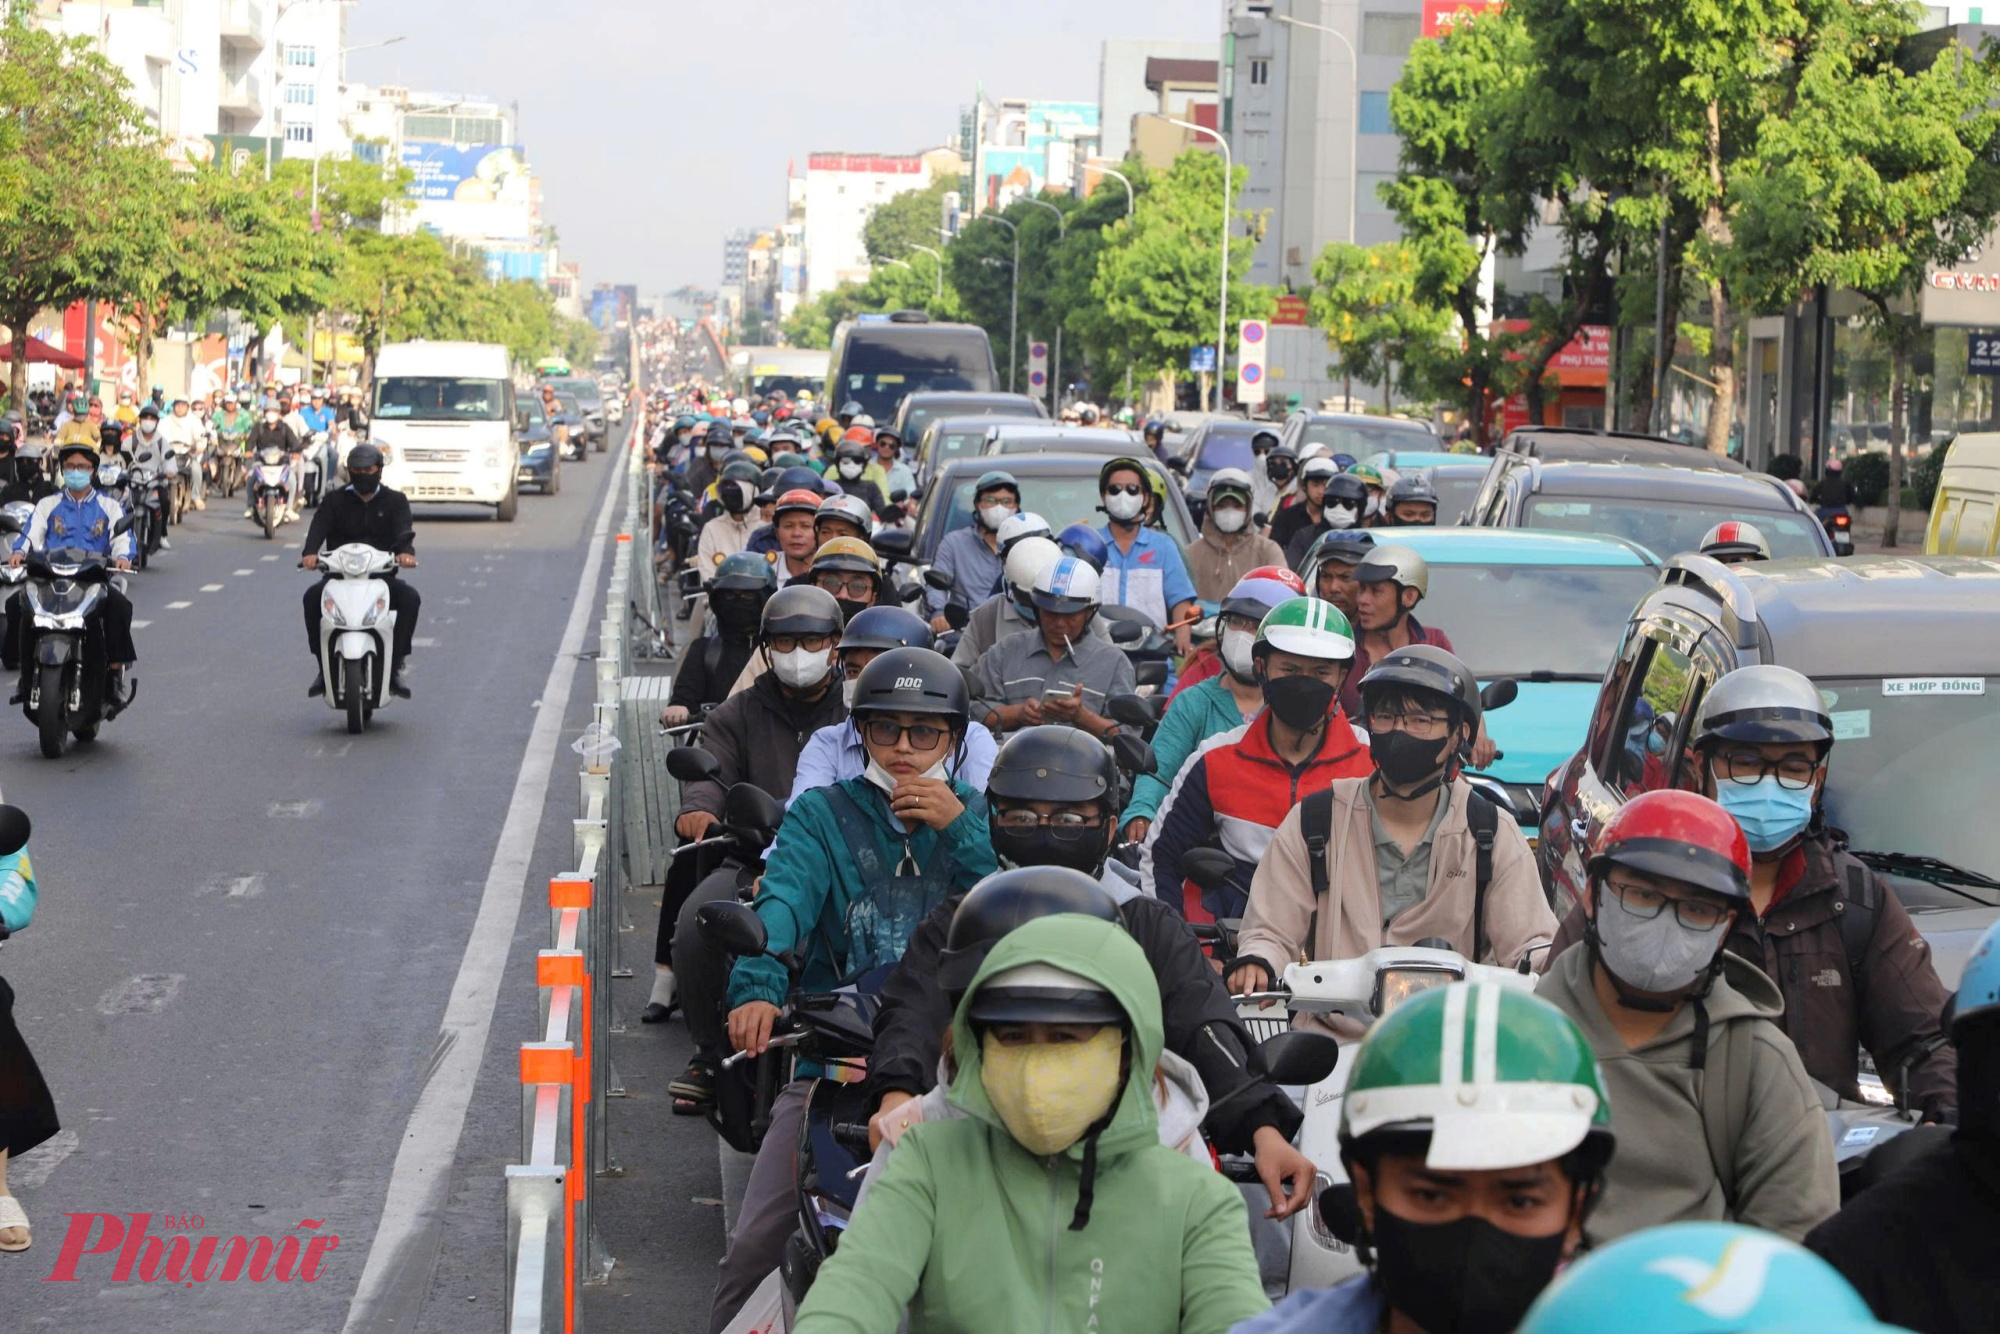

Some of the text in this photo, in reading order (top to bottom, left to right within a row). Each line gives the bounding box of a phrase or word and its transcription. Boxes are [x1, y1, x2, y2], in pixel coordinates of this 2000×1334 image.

[1931, 271, 1999, 291] GWM
[1887, 683, 1904, 691] XE
[1909, 681, 1937, 692] HỢP
[1087, 1257, 1104, 1334] QNFA
